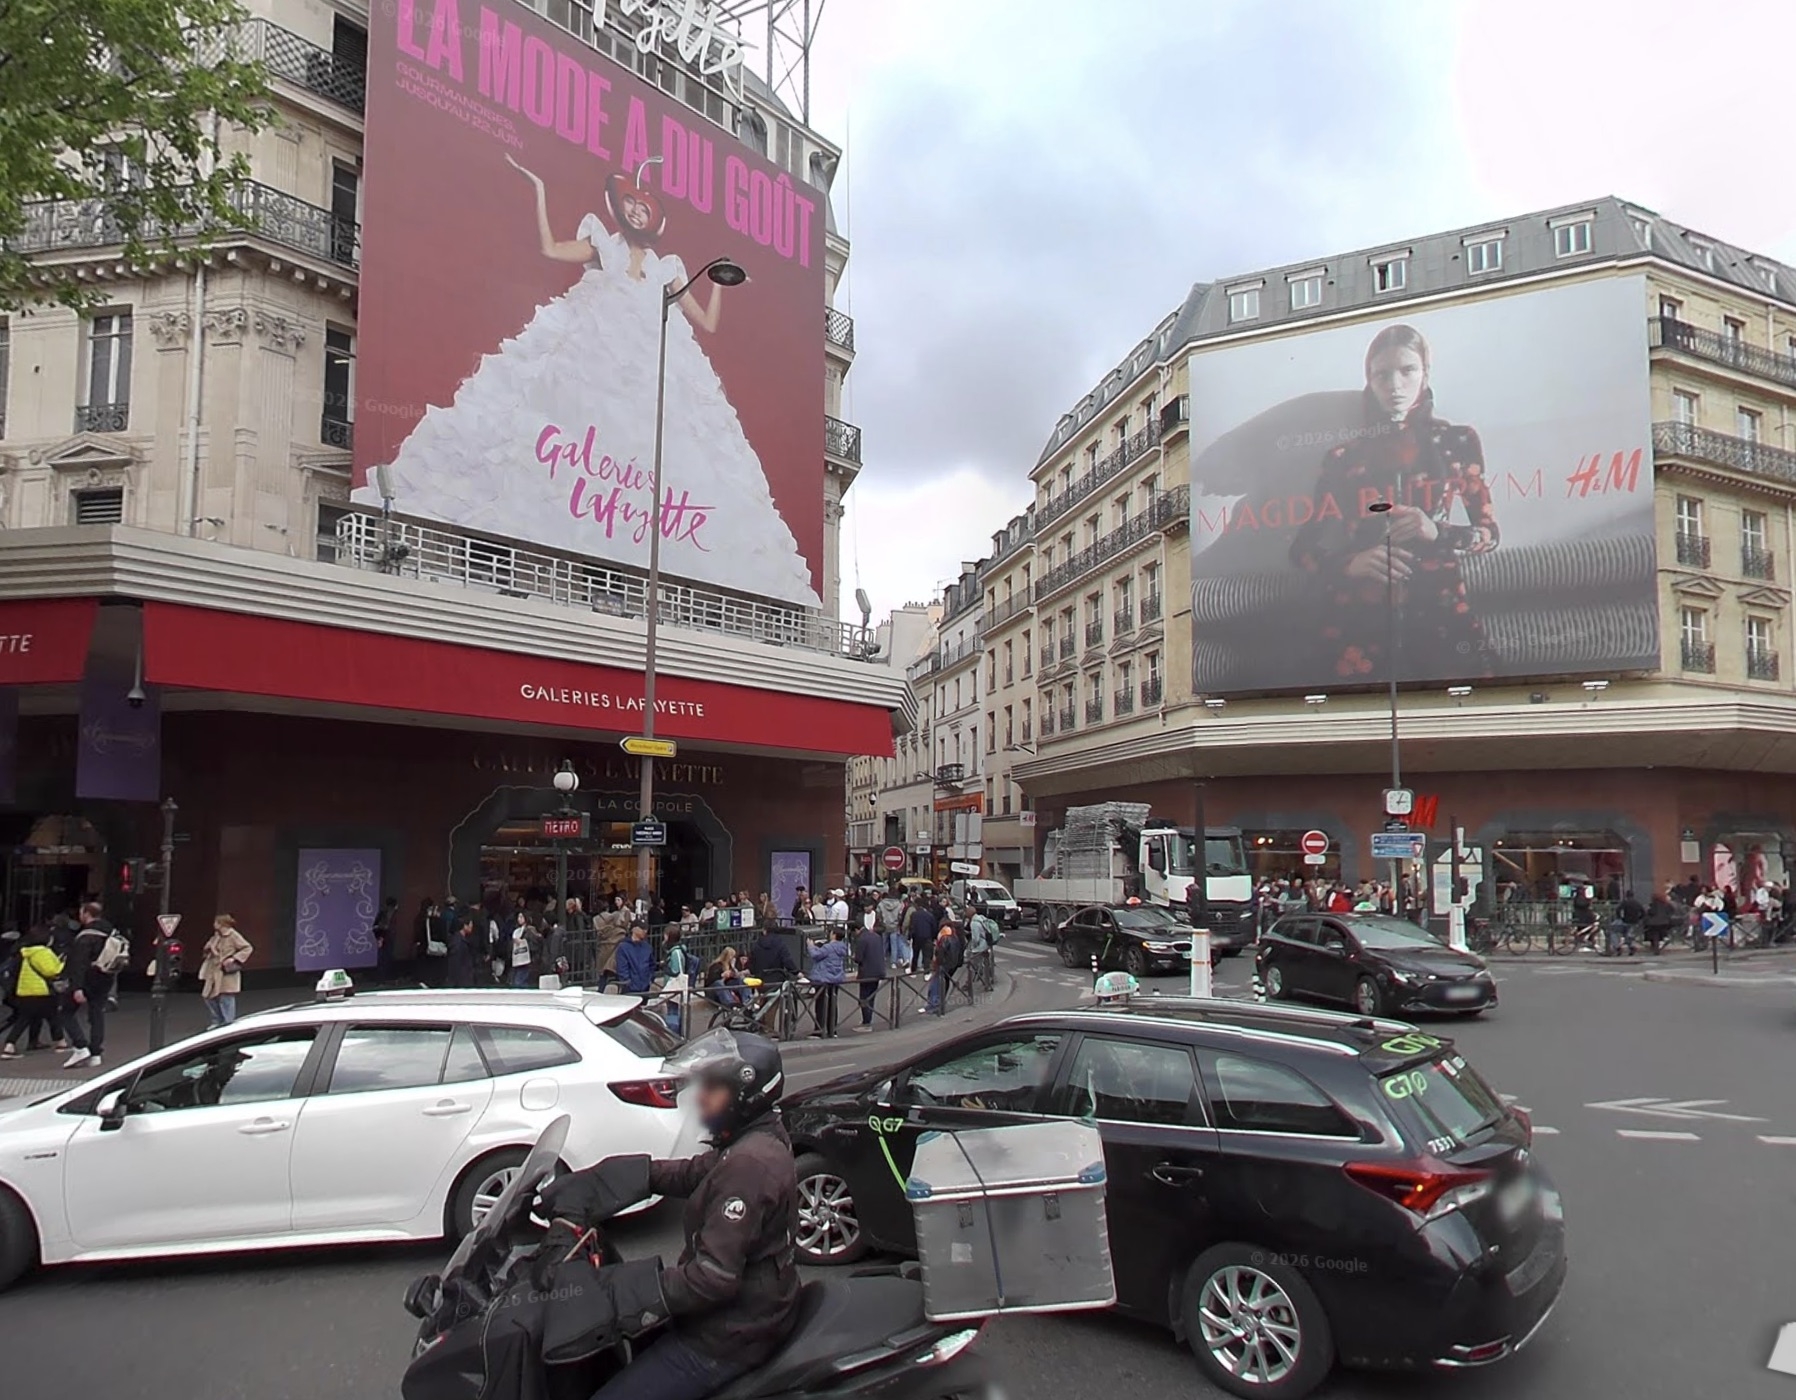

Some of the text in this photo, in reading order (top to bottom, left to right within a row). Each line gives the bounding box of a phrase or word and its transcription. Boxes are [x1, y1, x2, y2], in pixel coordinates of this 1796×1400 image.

[397, 0, 814, 268] LA MODE A DU GOÛT
[491, 127, 524, 149] JUIN
[535, 424, 657, 495] Galeries
[1199, 490, 1344, 537] MAGDA
[1565, 447, 1643, 499] H&M
[520, 684, 610, 708] GALERIES
[598, 799, 693, 813] LA COPOLE
[1427, 1135, 1456, 1154] 7531
